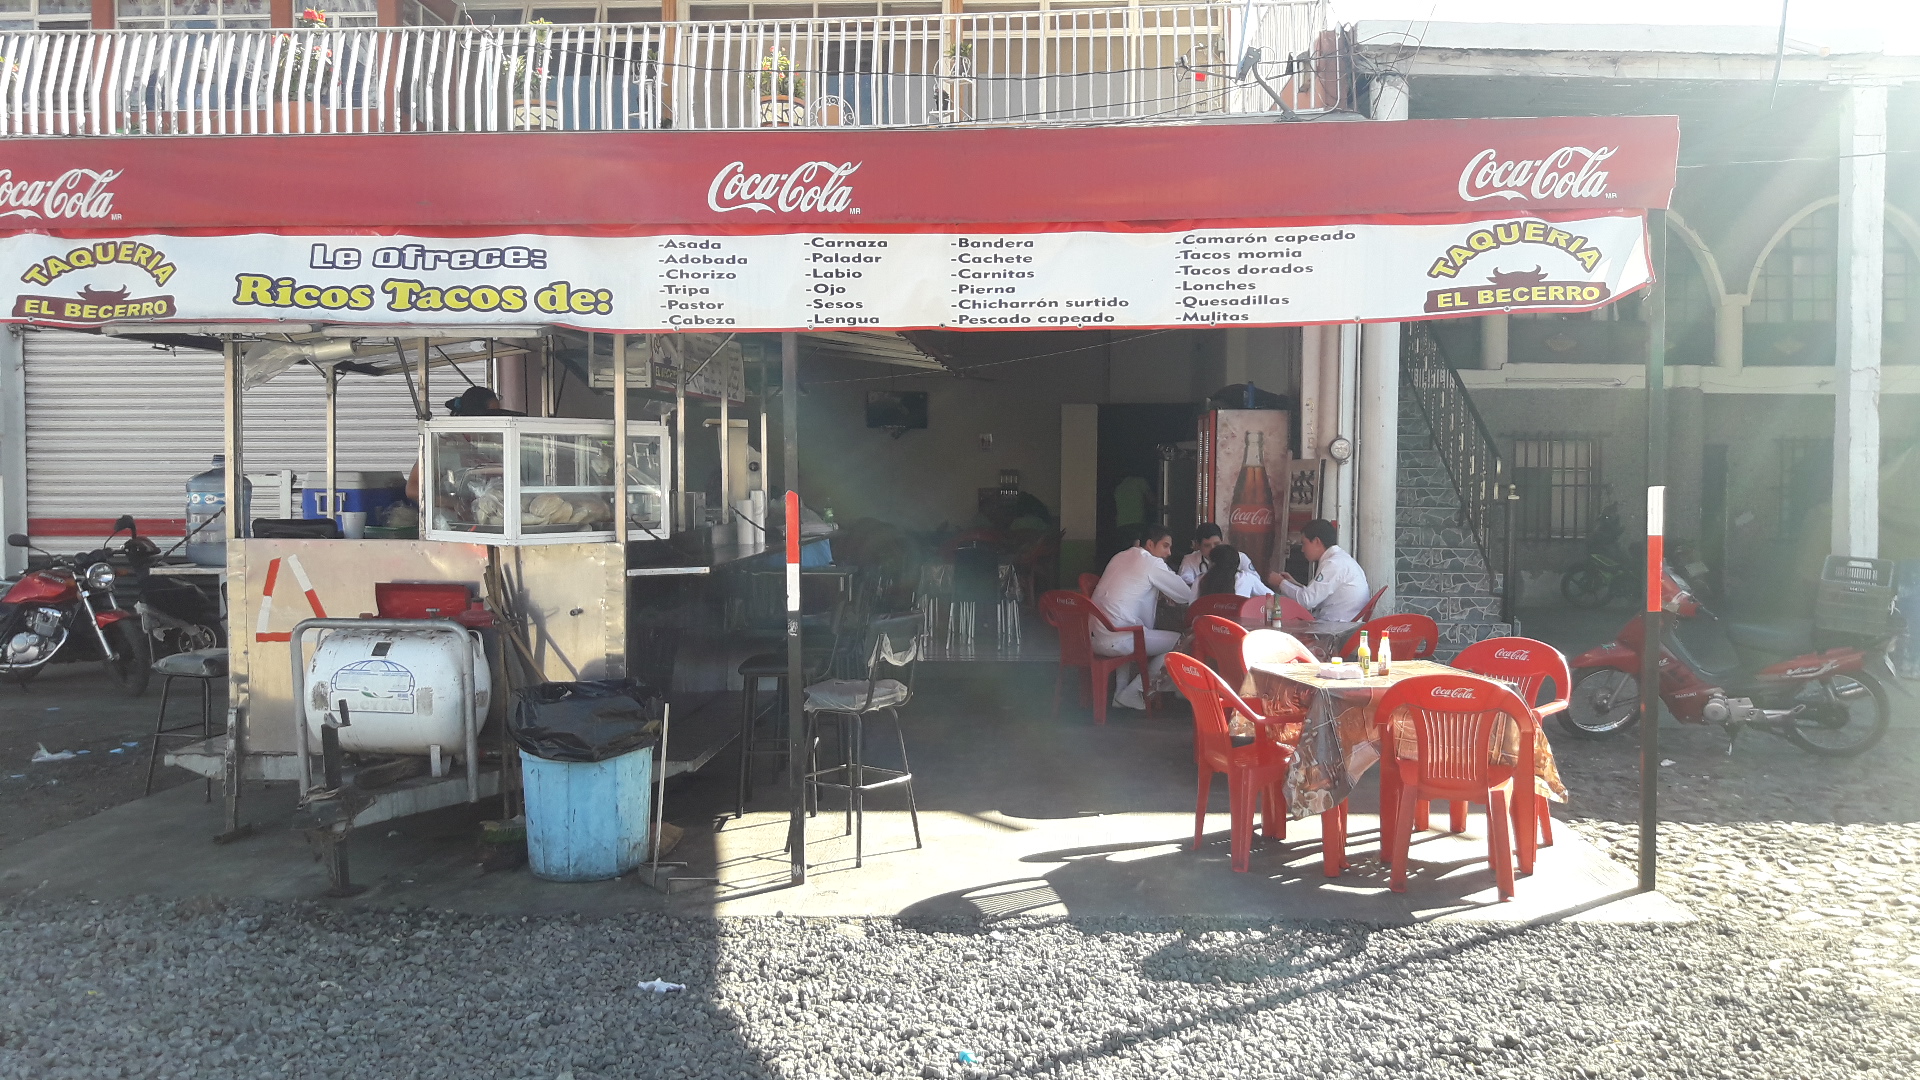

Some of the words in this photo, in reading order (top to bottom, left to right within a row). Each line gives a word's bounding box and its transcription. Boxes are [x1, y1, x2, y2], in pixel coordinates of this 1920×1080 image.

[1457, 146, 1619, 202] Coca-Cola
[707, 160, 863, 215] Coca-Cola
[849, 207, 861, 215] MR
[111, 213, 122, 221] MR
[803, 236, 888, 248] -Carnaza
[950, 237, 1034, 249] -Bandera
[1174, 231, 1268, 245] -Camarón
[1274, 229, 1356, 245] capeado
[658, 238, 722, 250] -Asada
[1427, 221, 1602, 279] TAQUERIA
[309, 243, 361, 269] Le
[372, 245, 548, 271] ofrece:
[658, 253, 748, 265] -Adobada
[804, 252, 883, 264] -Paladar
[950, 252, 1033, 264] -Cachete
[1174, 247, 1231, 260] -Tacos
[1237, 247, 1302, 259] momia
[21, 241, 177, 287] TAQUERIA
[1174, 264, 1231, 276] -Tacos
[1237, 262, 1314, 275] dorados
[658, 268, 737, 280] -Chorizo
[804, 267, 863, 279] -Labio
[950, 268, 1035, 280] -Carnitas
[658, 284, 710, 297] -Tripa
[805, 283, 847, 297] -Ojo
[950, 283, 1016, 295] -Pierna
[1174, 279, 1257, 291] -Lonches
[234, 273, 375, 311] Ricos
[381, 278, 528, 313] Tacos
[533, 280, 613, 315] de:
[1437, 293, 1469, 308] EL
[1477, 286, 1600, 305] BECERRO
[659, 299, 725, 310] -Pastor
[805, 298, 864, 310] -Sesos
[950, 297, 1059, 310] -Chicharrón
[1065, 296, 1130, 308] surtido
[1174, 294, 1290, 309] -Quesadillas
[25, 299, 56, 315] EL
[64, 300, 168, 319] BECERRO
[661, 314, 736, 326] -Cabeza
[806, 313, 880, 326] -Lengua
[951, 313, 1032, 325] -Pescado
[1036, 312, 1116, 326] capeado
[1175, 310, 1249, 322] -Mulitas
[1230, 508, 1273, 525] Coca-Cola
[1494, 648, 1530, 661] Coca-Cola
[1430, 686, 1475, 699] Coca-Cola
